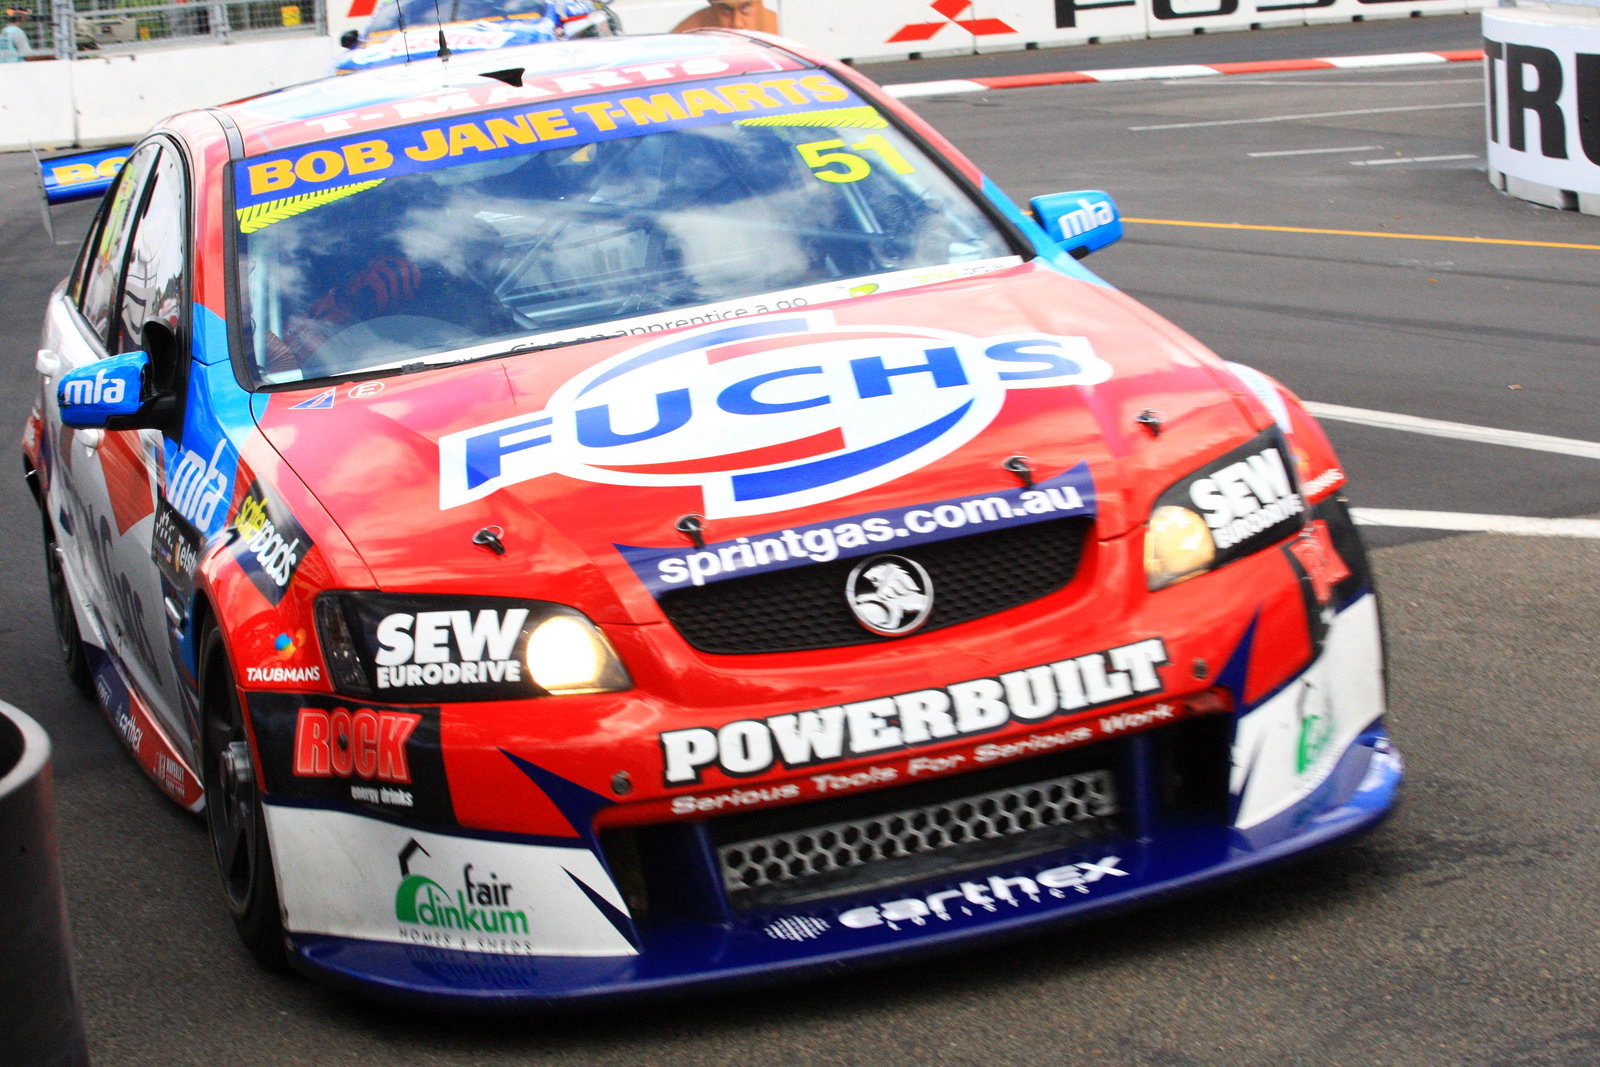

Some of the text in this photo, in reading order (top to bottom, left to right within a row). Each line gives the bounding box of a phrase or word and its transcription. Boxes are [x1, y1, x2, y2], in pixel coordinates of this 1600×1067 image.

[248, 75, 850, 196] BOB JANE T-MARTS
[796, 133, 916, 183] 51
[64, 368, 126, 405] mfa
[464, 339, 1083, 491] FUCHS
[167, 438, 228, 533] mfa
[1189, 448, 1293, 528] SEW
[657, 485, 1085, 587] sprintgas.com.au
[246, 666, 321, 682] TAUBMANS
[375, 608, 530, 667] SEW
[376, 660, 521, 689] EURODRIVE
[293, 706, 423, 784] ROCK
[660, 637, 1168, 784] POWERBUILT
[671, 703, 1175, 815] Serious Tools For Serious Work
[417, 885, 530, 935] dinkum
[463, 862, 513, 907] fair
[838, 855, 1130, 930] earthex
